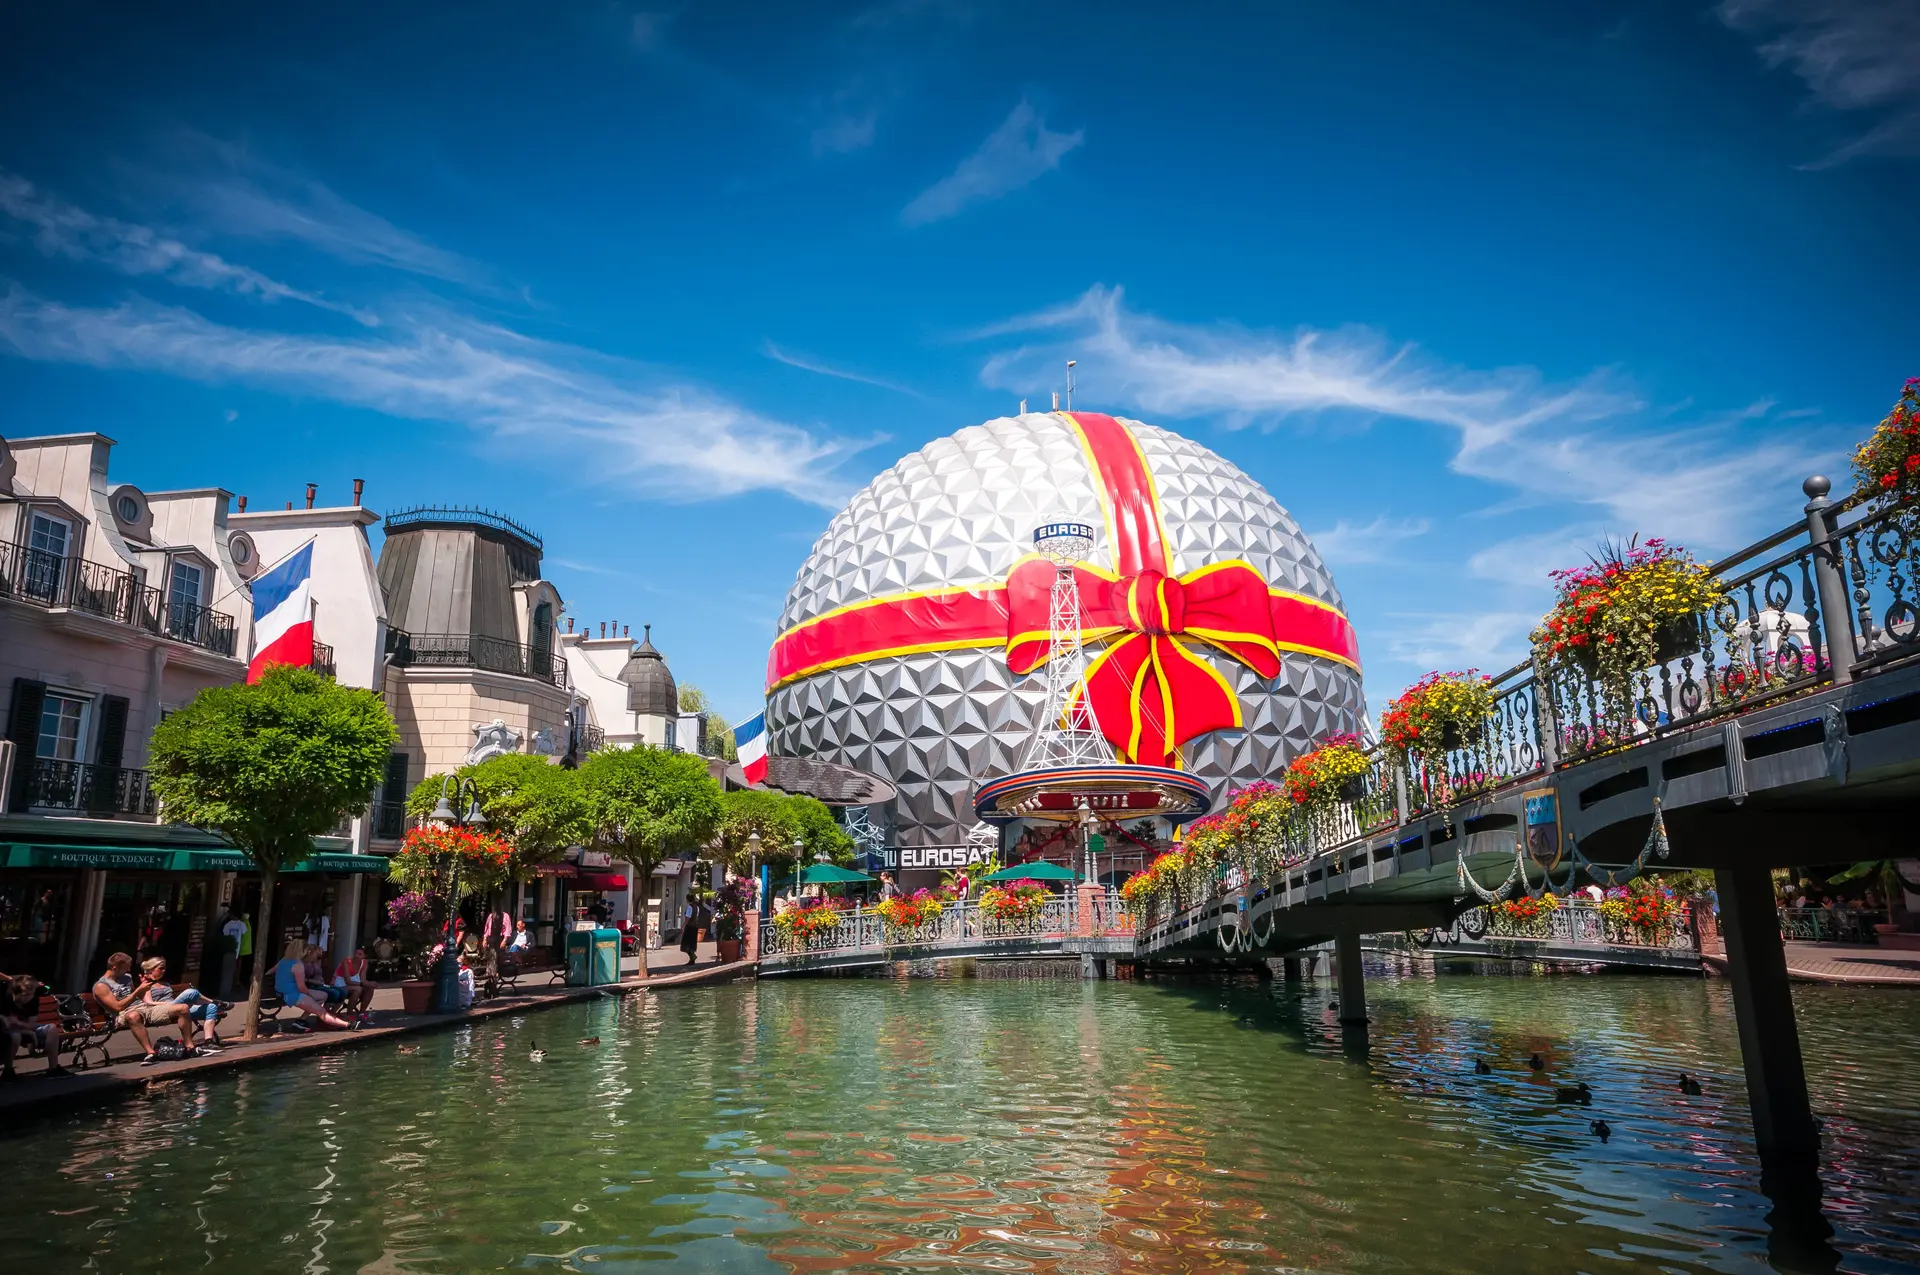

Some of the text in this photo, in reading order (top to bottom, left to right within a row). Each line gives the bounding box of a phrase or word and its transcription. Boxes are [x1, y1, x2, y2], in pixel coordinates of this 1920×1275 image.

[61, 853, 155, 864] BOUTIQUE TENDENCE
[211, 858, 245, 868] BOUTIQUE
